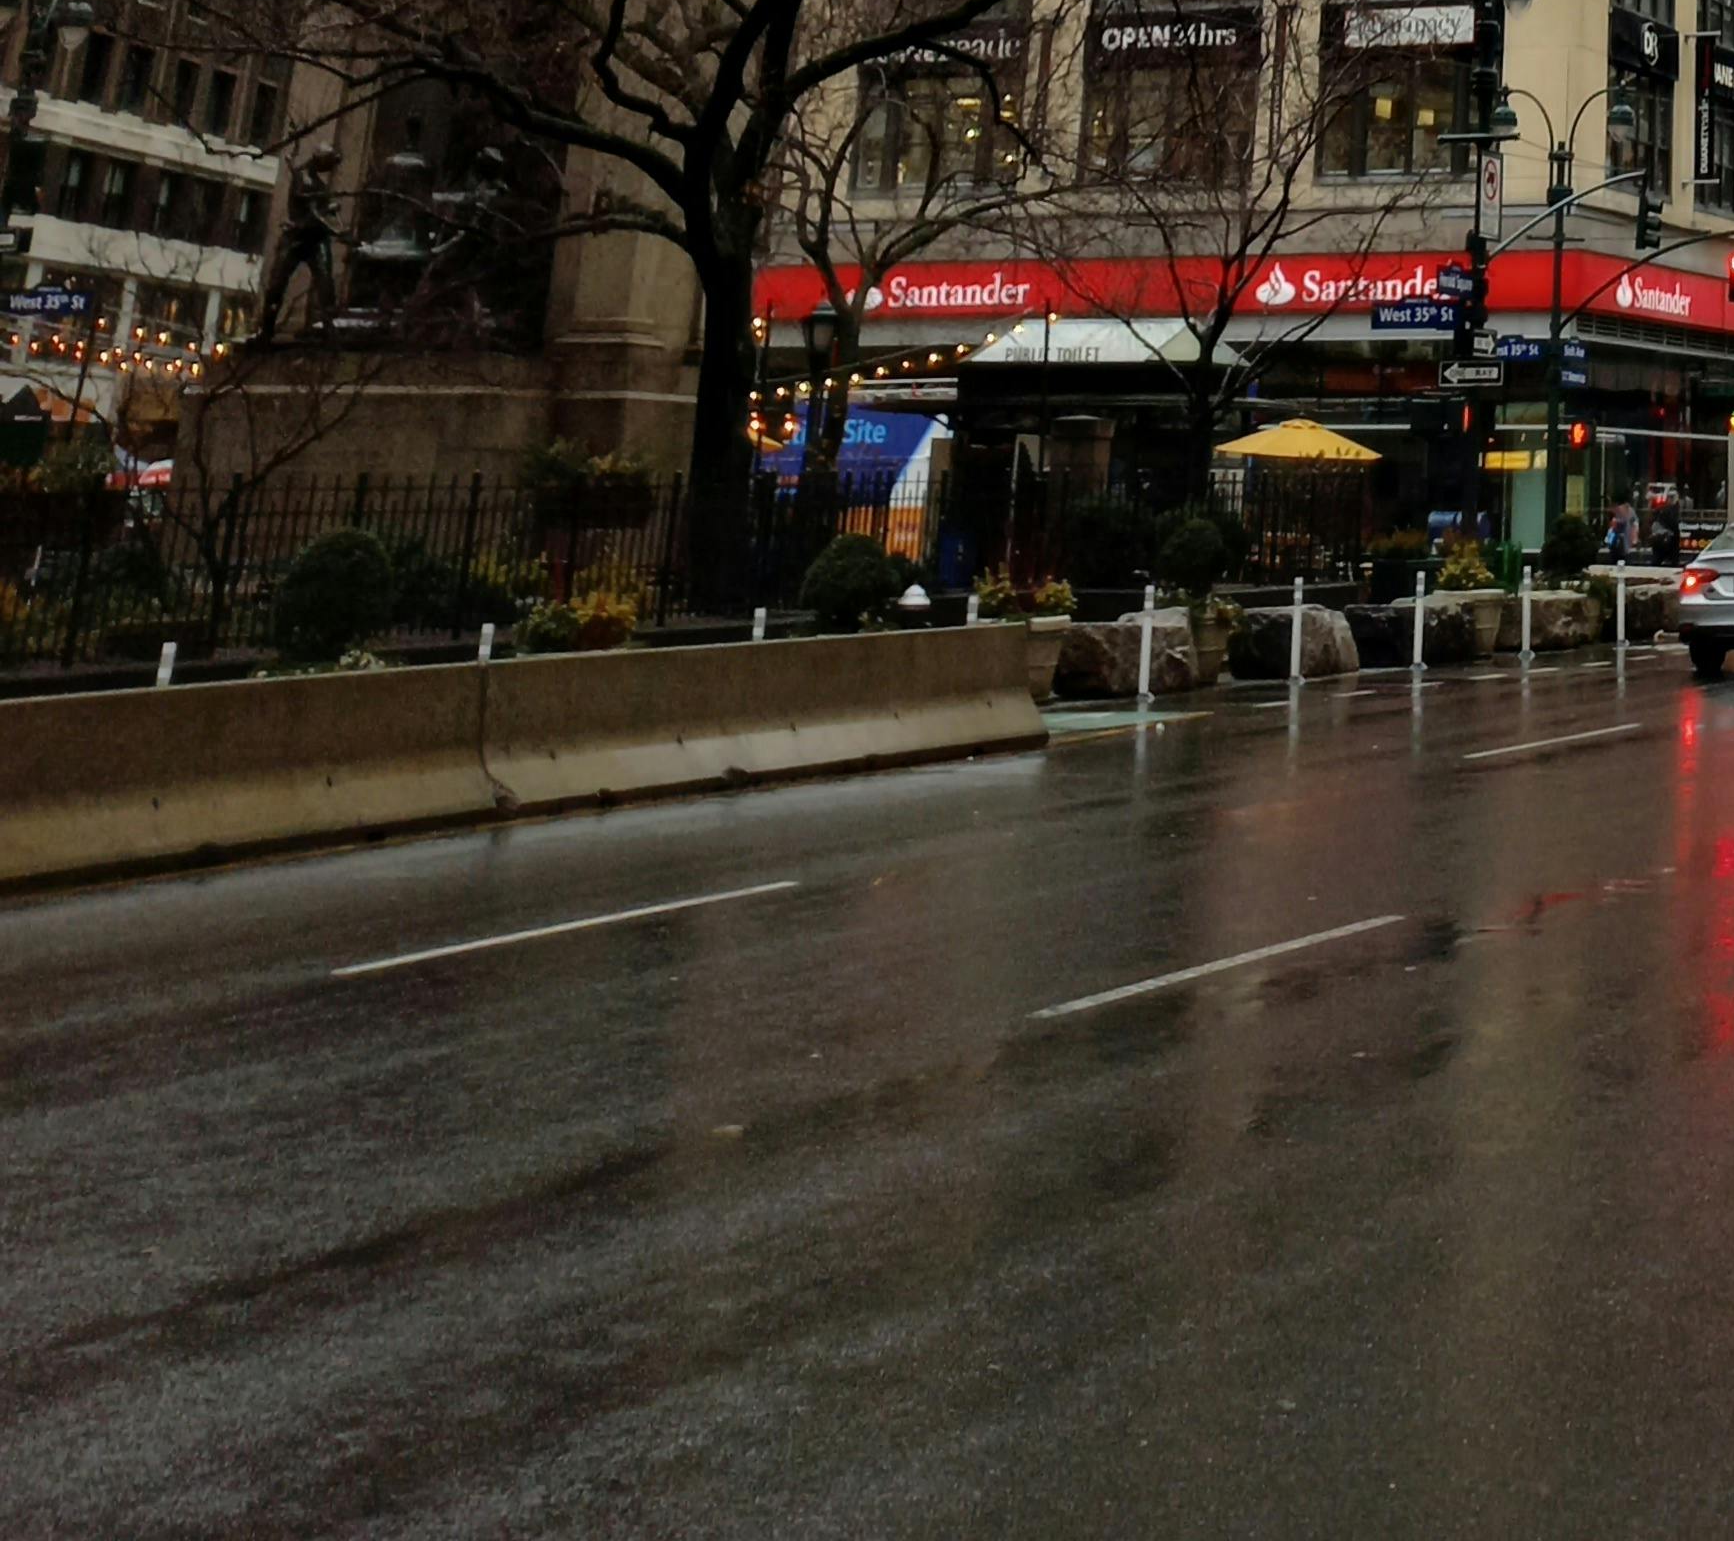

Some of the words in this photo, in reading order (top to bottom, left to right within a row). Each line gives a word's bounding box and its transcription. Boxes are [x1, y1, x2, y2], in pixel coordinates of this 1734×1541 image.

[887, 271, 1030, 308] Santander
[1302, 265, 1450, 303] Santande
[1634, 277, 1691, 317] Santander
[1379, 307, 1411, 322] West
[1441, 306, 1453, 321] St
[842, 418, 887, 444] Site
